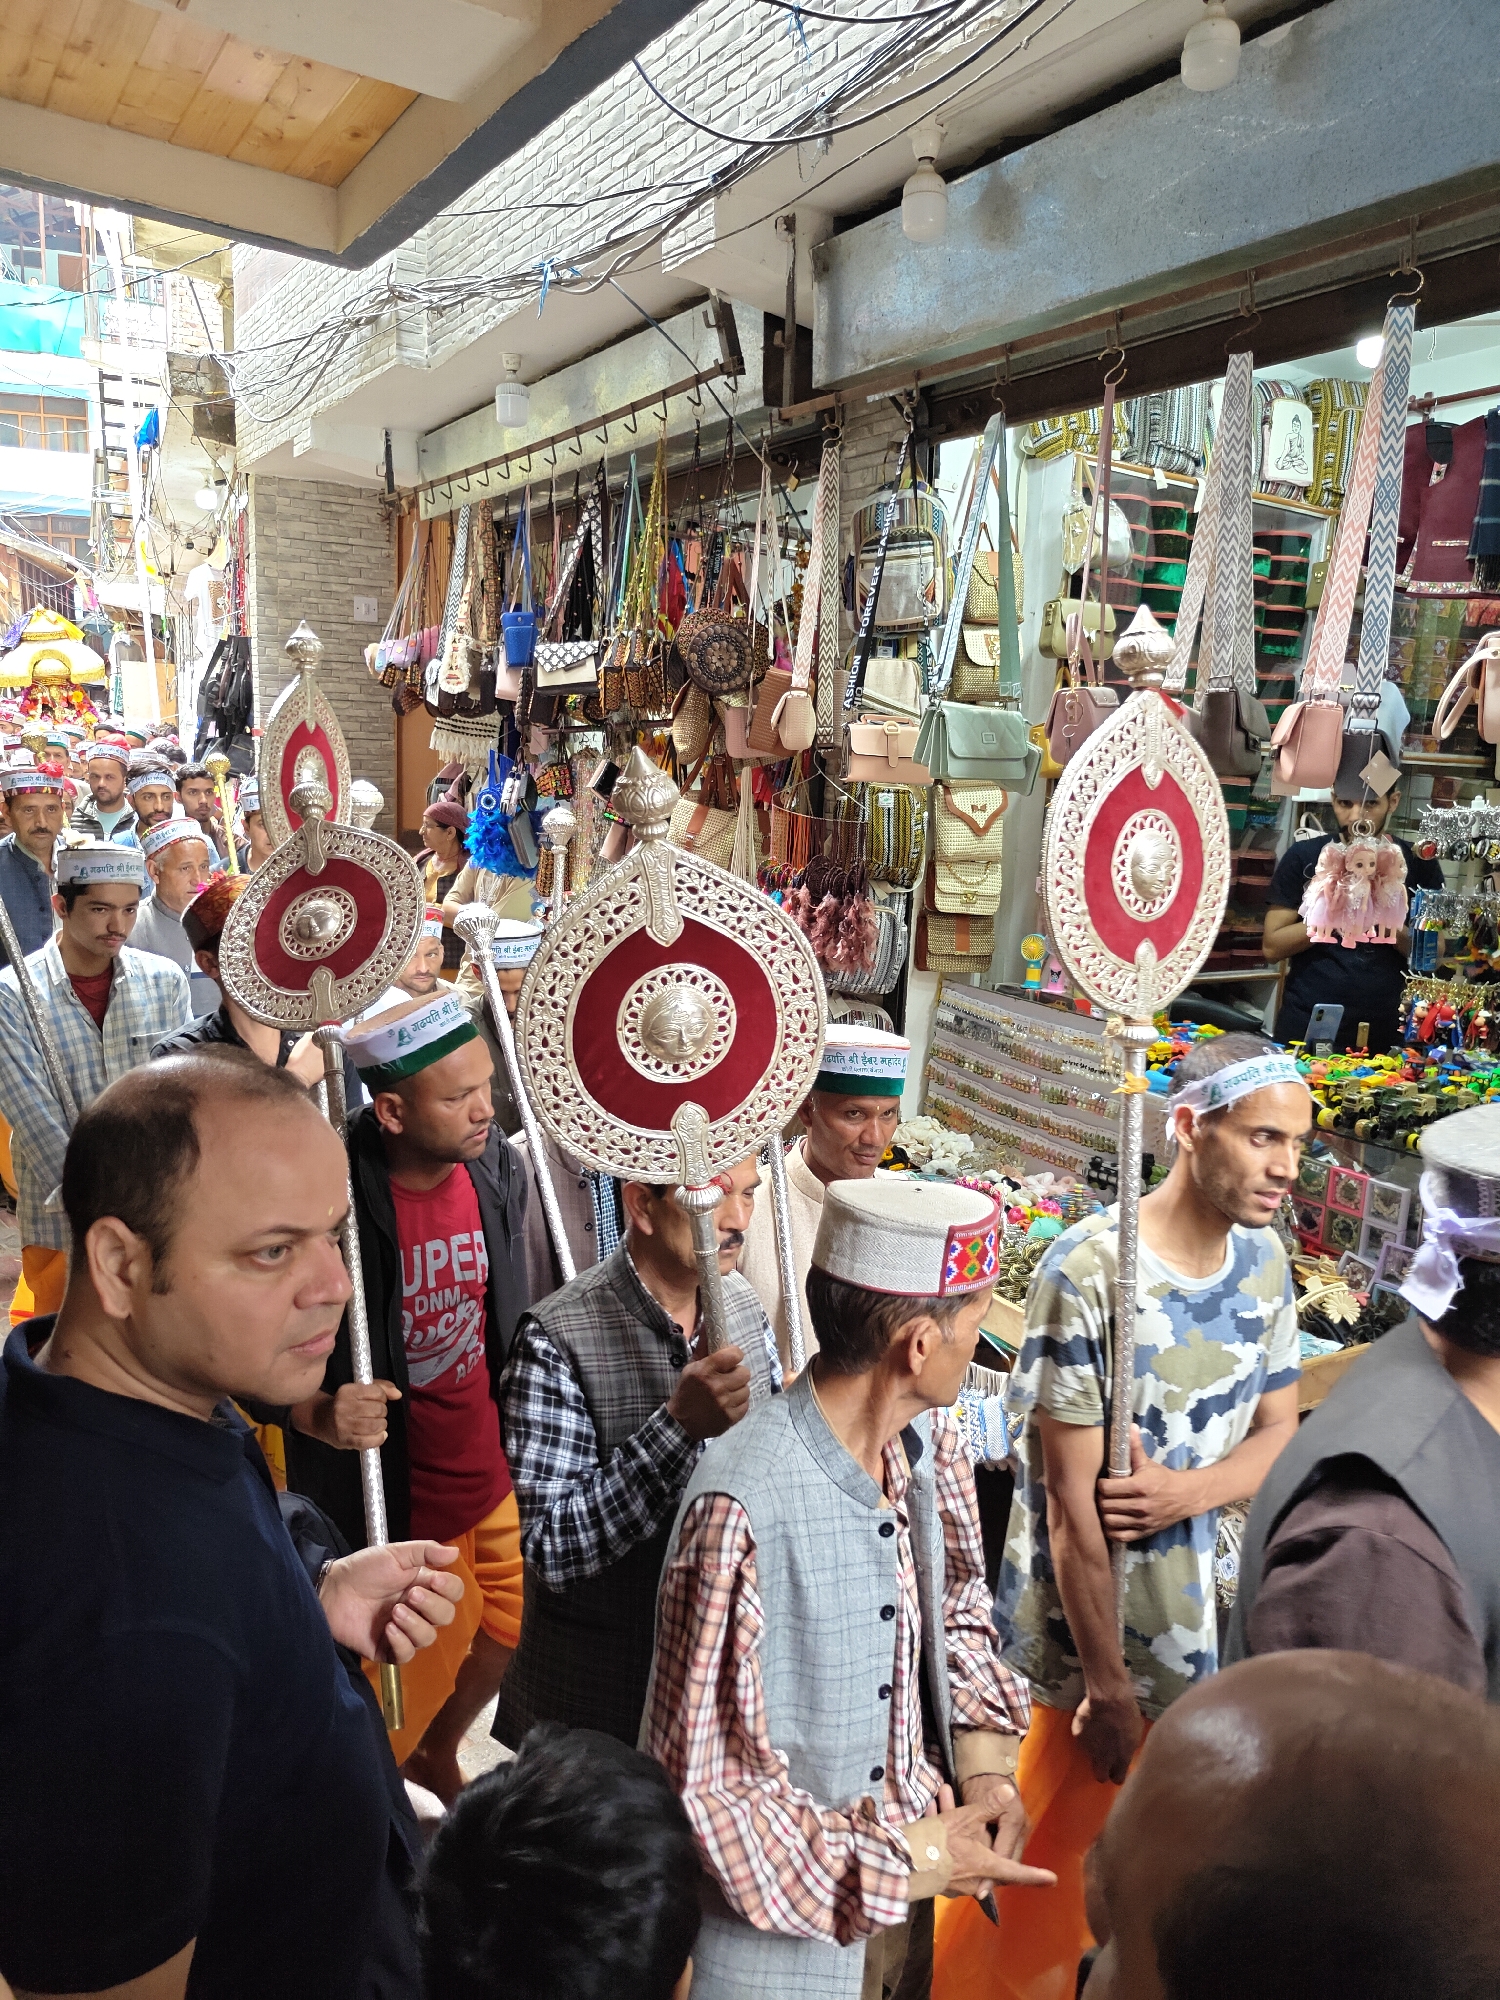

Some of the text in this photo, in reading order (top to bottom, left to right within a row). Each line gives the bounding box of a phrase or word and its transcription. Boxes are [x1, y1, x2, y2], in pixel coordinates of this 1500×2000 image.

[843, 655, 862, 709] ASHION
[858, 565, 882, 638] FOREVER
[877, 492, 897, 557] FASHION
[400, 1230, 489, 1298] UPER
